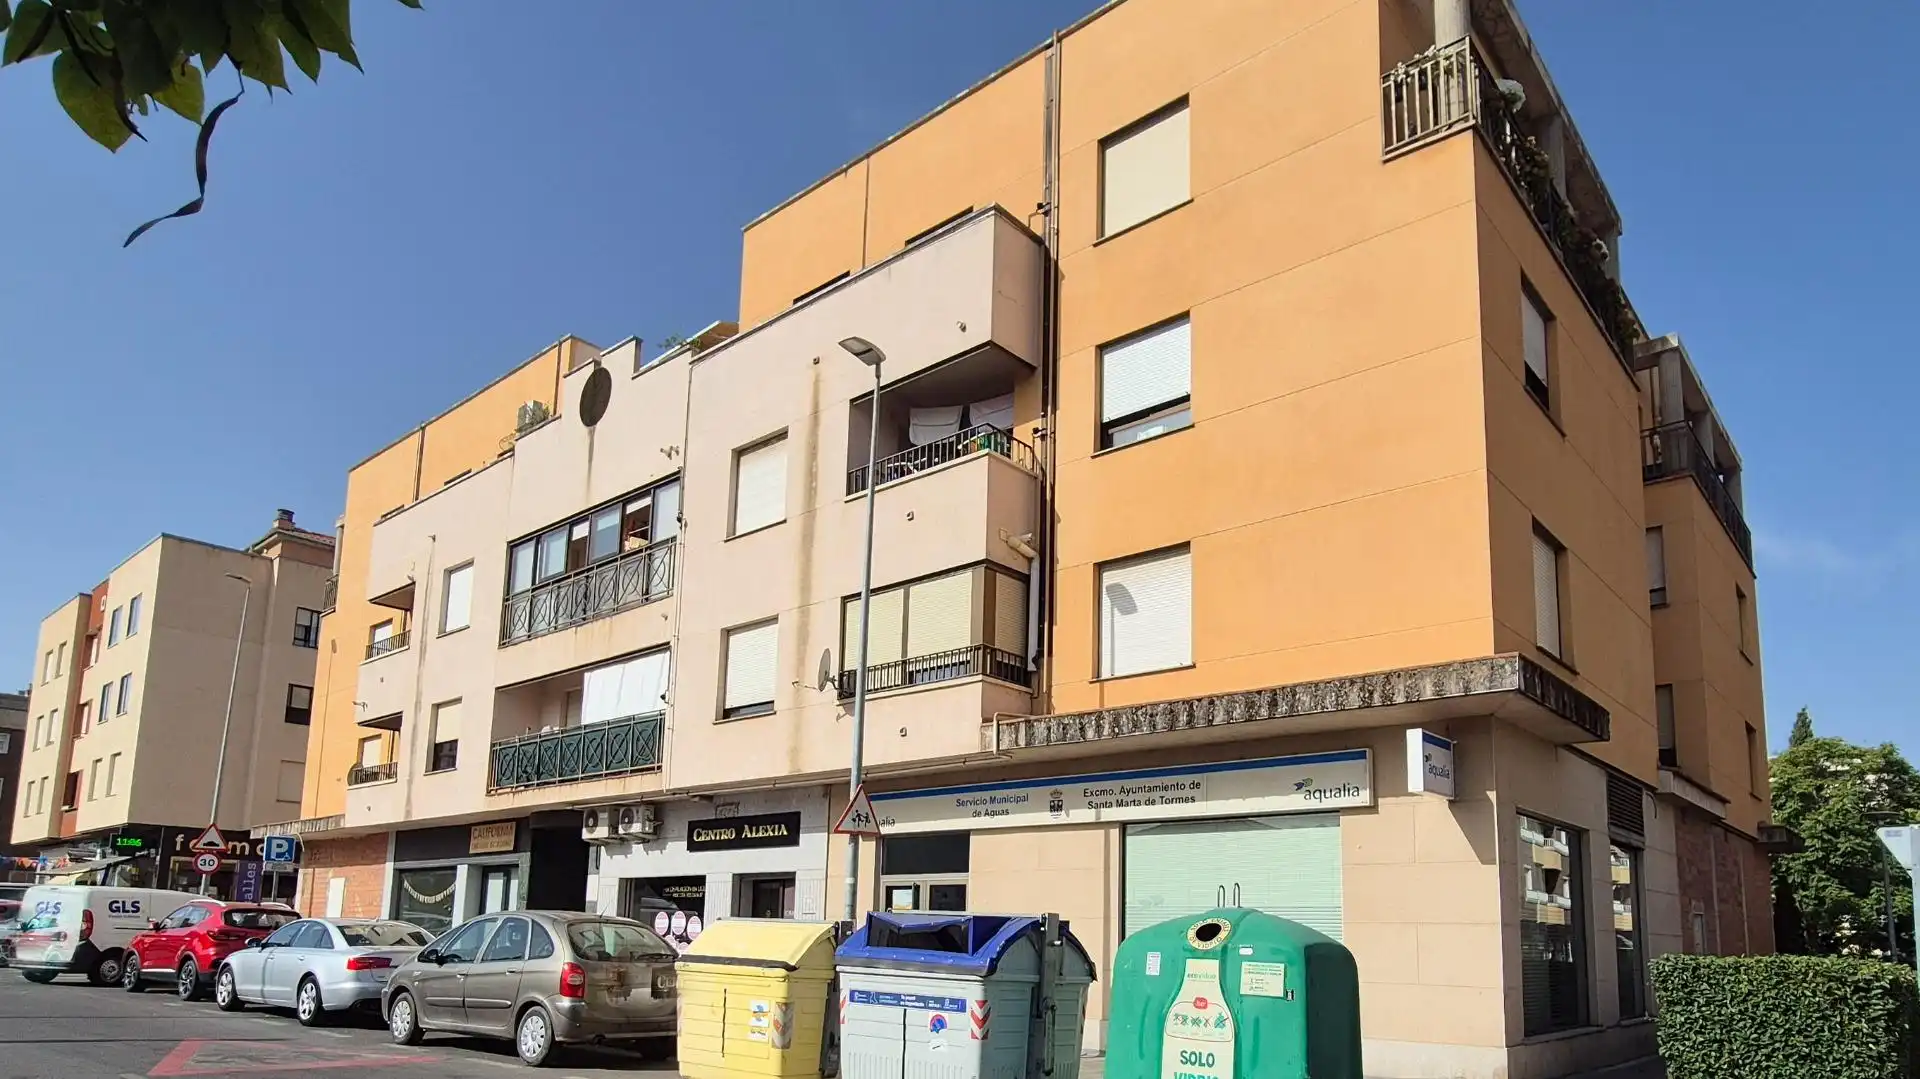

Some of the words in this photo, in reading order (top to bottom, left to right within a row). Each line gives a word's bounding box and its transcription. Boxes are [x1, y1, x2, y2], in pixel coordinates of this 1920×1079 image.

[1428, 763, 1450, 779] aqualia
[1083, 788, 1117, 797] Excmo.
[1119, 782, 1186, 796] Ayuntamiento
[1188, 780, 1201, 790] de
[1304, 783, 1360, 802] aqualia
[956, 797, 987, 807] Servicio
[989, 793, 1029, 805] Municipal
[1087, 800, 1113, 809] Santa
[1115, 798, 1142, 808] Marta
[1144, 796, 1157, 806] de
[1159, 795, 1196, 805] Tormes
[972, 809, 982, 818] de
[983, 808, 1010, 818] Aguas
[693, 828, 736, 842] CENTRO
[742, 824, 788, 838] ALEXIA
[271, 839, 289, 860] P
[199, 858, 215, 867] 30
[36, 901, 62, 915] GLS
[108, 899, 141, 914] GLS
[1180, 1049, 1216, 1069] SOLO
